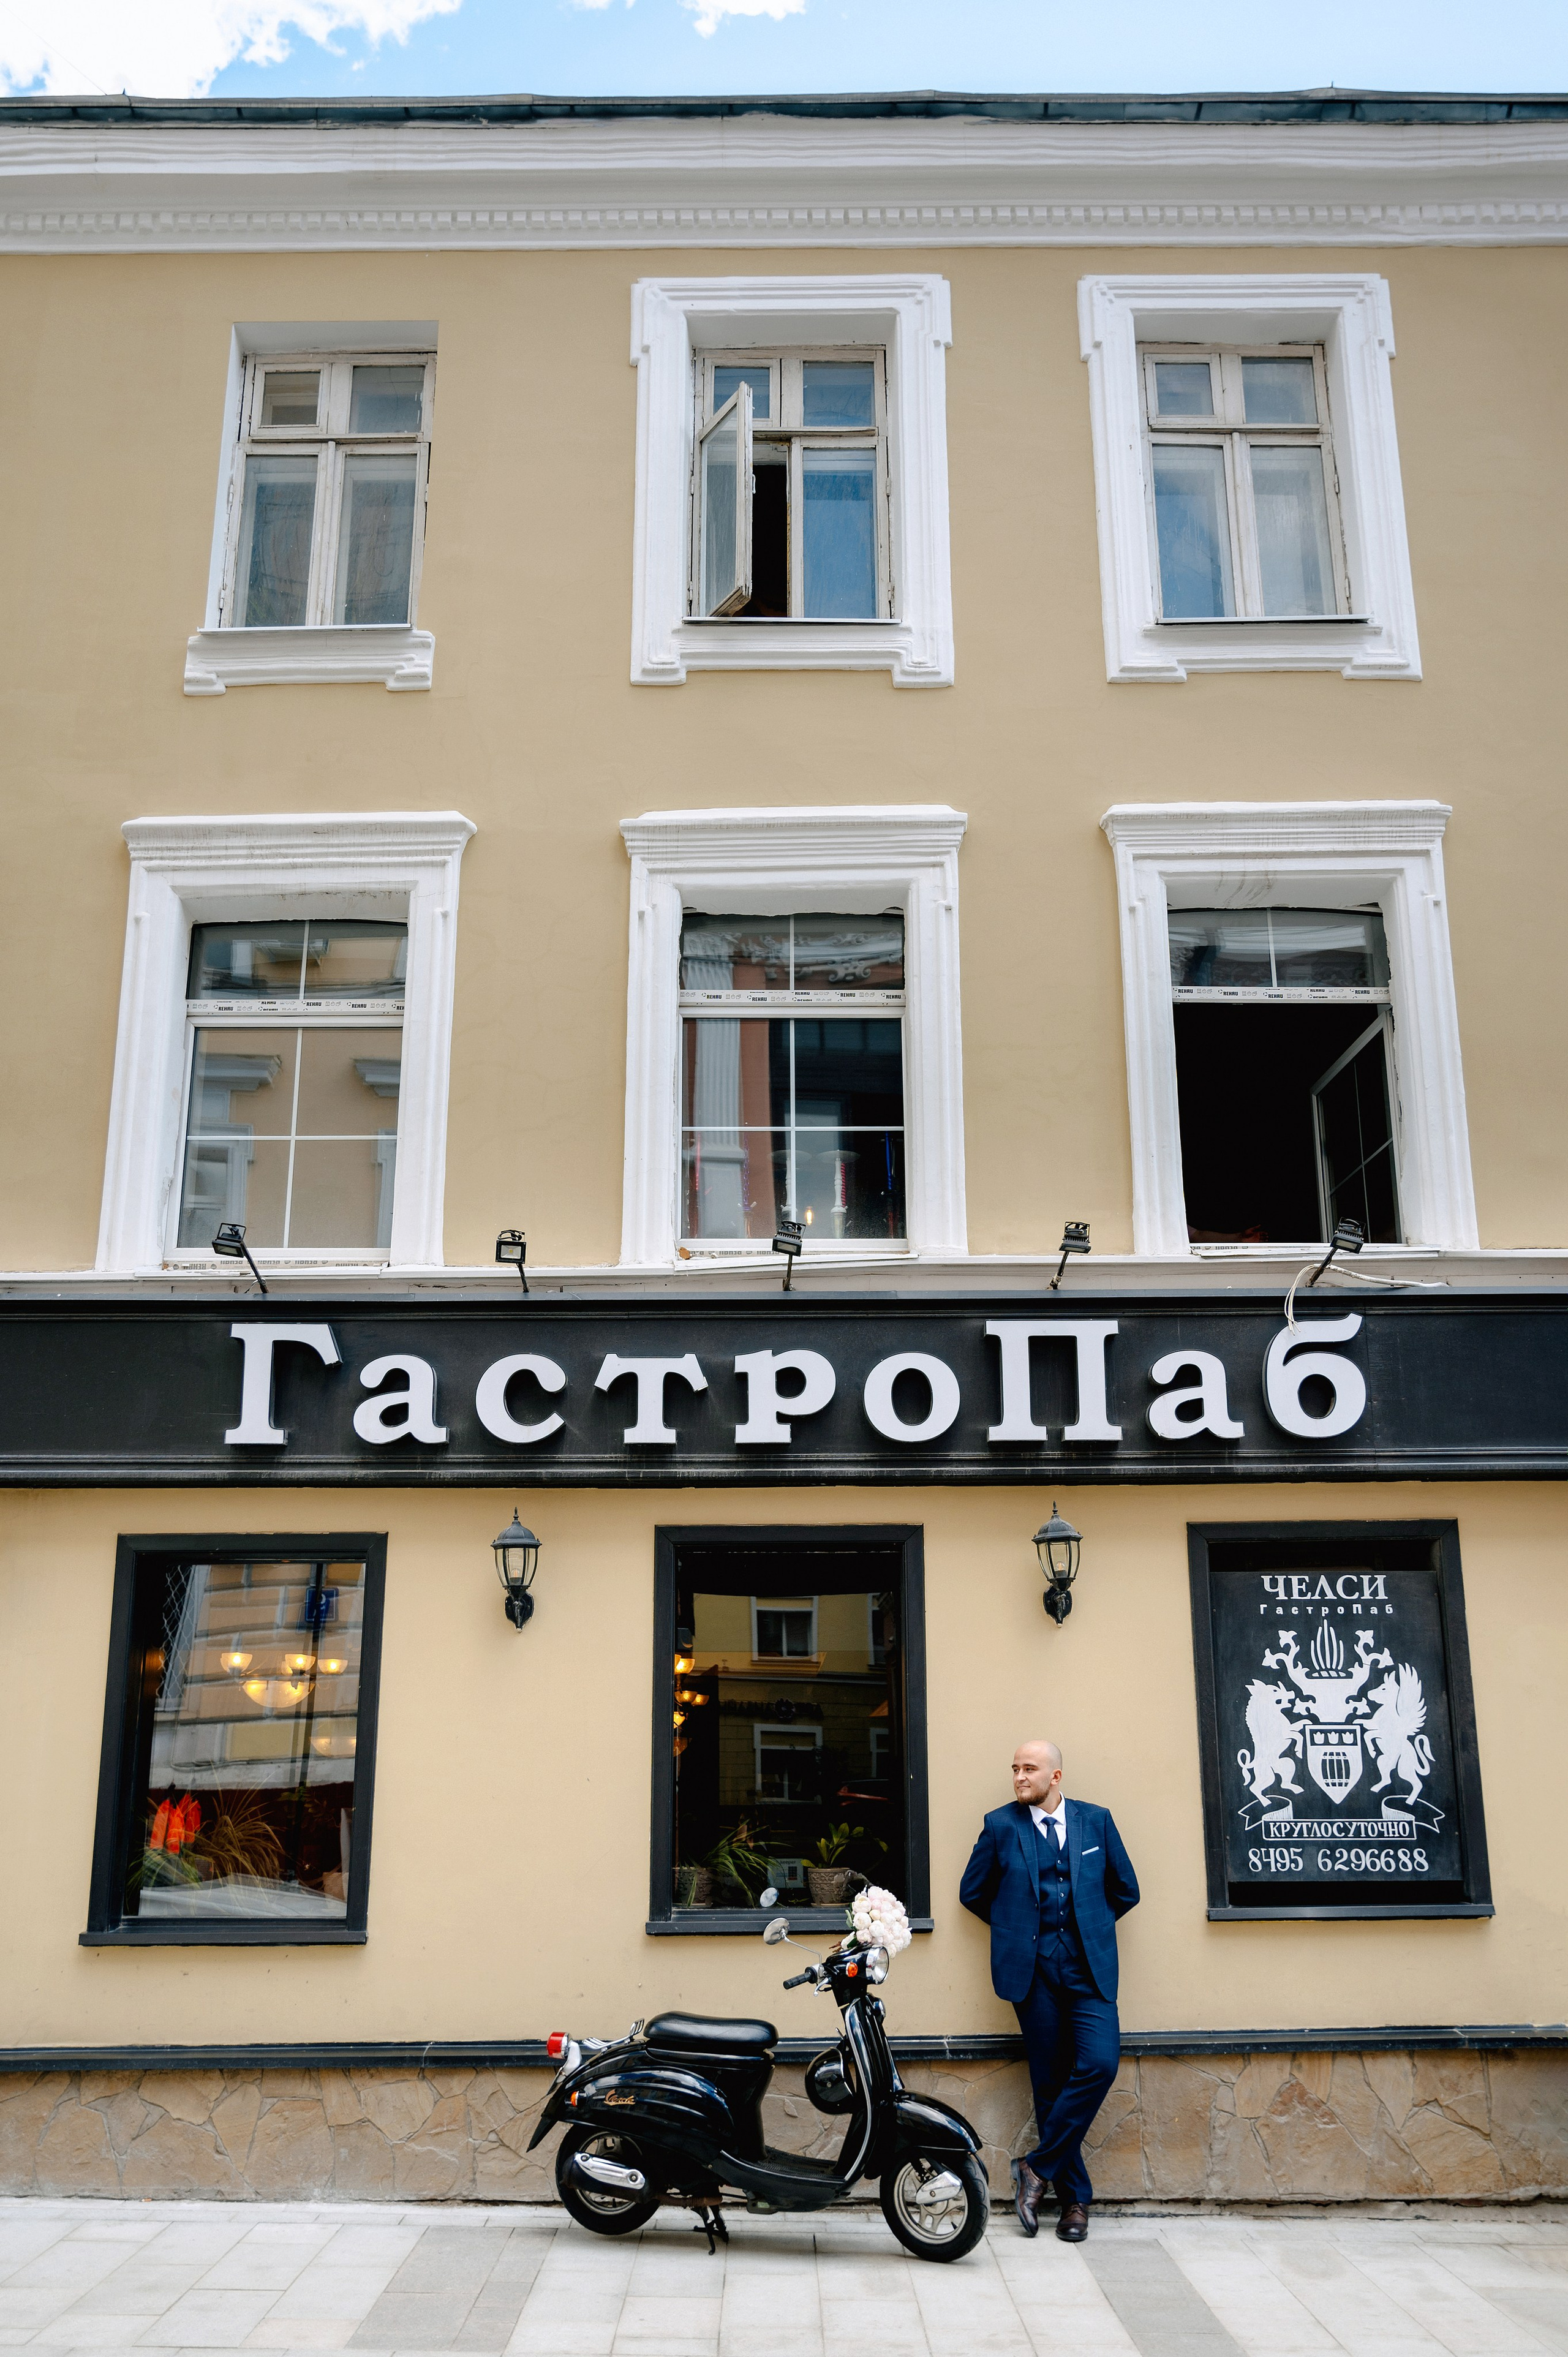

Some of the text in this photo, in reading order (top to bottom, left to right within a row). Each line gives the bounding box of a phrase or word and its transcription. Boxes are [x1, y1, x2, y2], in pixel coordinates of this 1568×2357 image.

[224, 1313, 1366, 1446] ГастроПаб
[1261, 1575, 1389, 1601] ЧЕЛСИ
[1259, 1604, 1394, 1616] ГастроПаб
[1269, 1821, 1410, 1838] КРУГЛОСУТОЧНО
[1249, 1847, 1430, 1872] 8495 6296688
